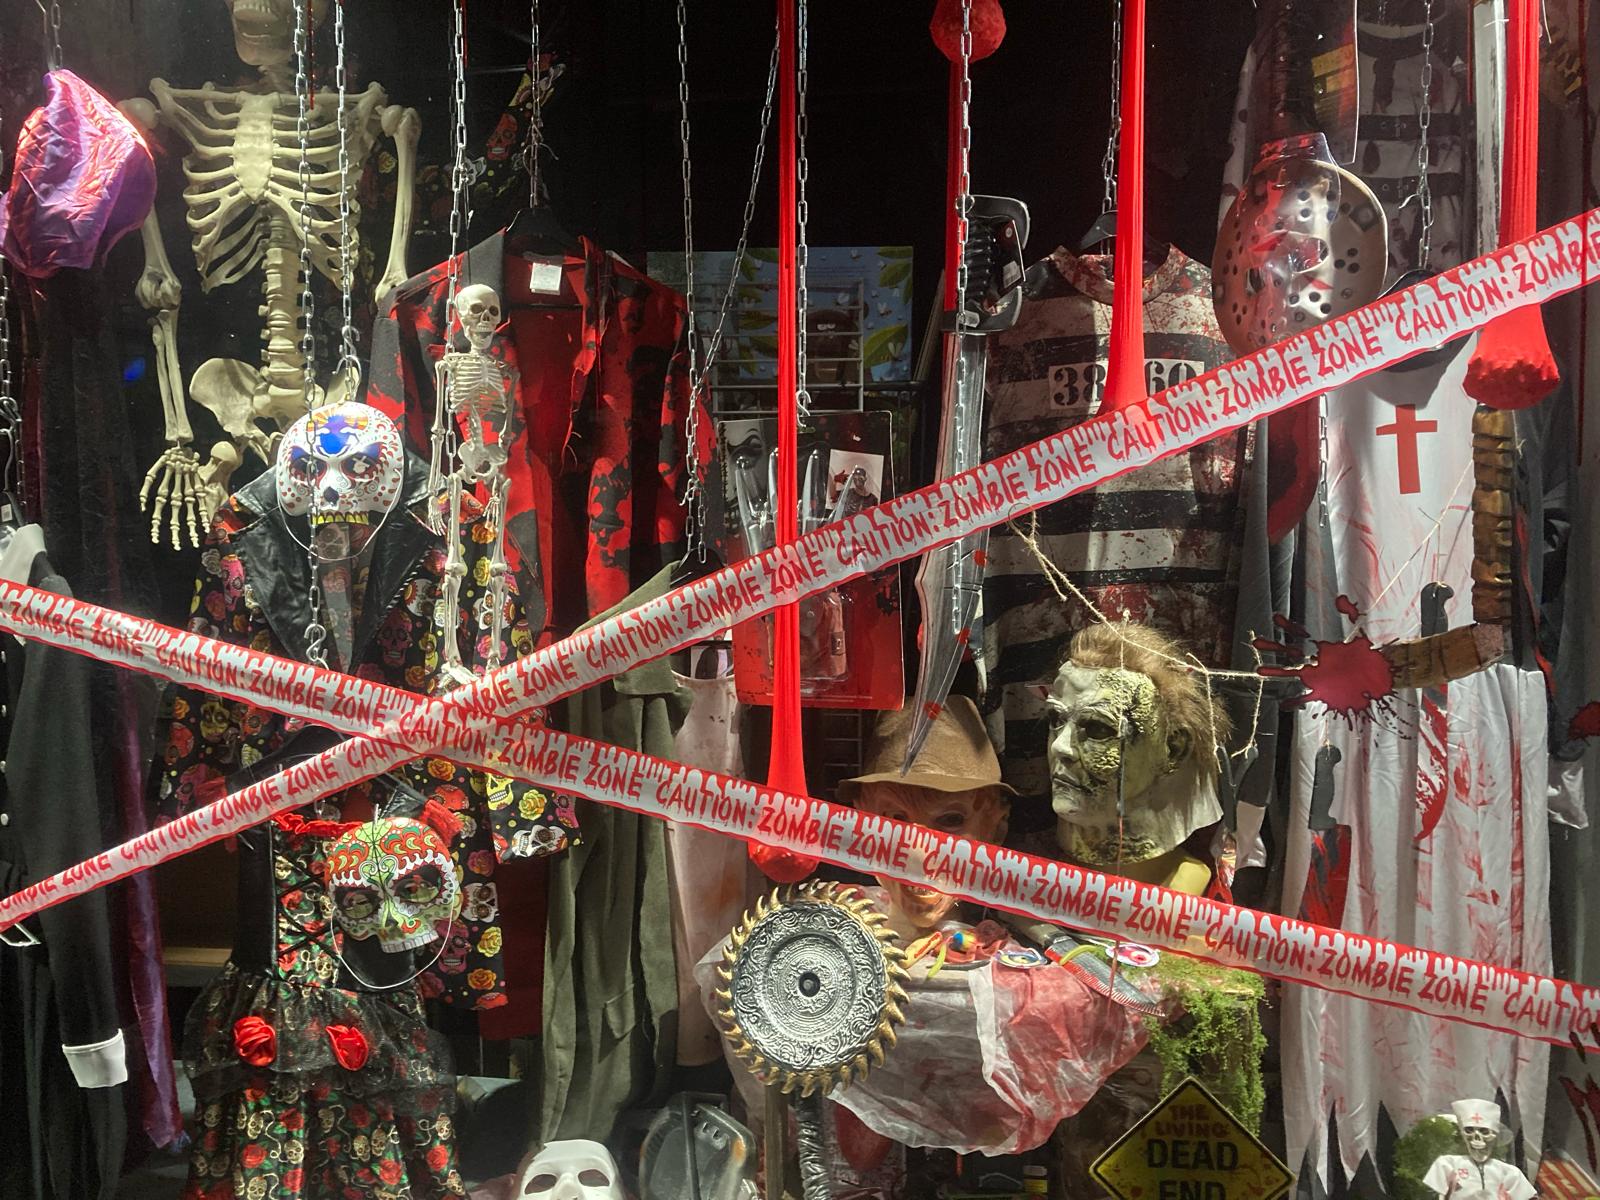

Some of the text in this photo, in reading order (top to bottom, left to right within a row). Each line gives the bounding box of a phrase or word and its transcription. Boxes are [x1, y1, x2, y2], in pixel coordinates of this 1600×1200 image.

[210, 778, 282, 826] ZOMBIE
[283, 754, 338, 796] ZONE
[518, 652, 577, 697] ZONE
[585, 615, 684, 669] CAUTION:
[681, 575, 764, 630] ZOMBIE
[765, 550, 827, 596] ZONE
[837, 510, 940, 565] CAUTION:
[938, 472, 1028, 528] ZOMBIE
[1029, 446, 1096, 492] ZONE
[1107, 398, 1218, 460] CAUTION:
[1216, 356, 1312, 417] ZOMBIE
[1312, 326, 1383, 377] ZONE
[1395, 275, 1514, 341] CAUTION:
[9, 601, 84, 640] ZOMBIE
[91, 627, 144, 657] ZONE
[156, 648, 246, 689] CAUTION:
[250, 669, 326, 710] ZOMBIE
[330, 691, 386, 729] ZONE
[400, 711, 496, 759] CAUTION:
[498, 737, 579, 782] ZOMBIE
[584, 761, 644, 798] ZONE
[656, 780, 753, 828] CAUTION:
[757, 807, 843, 851] ZOMBIE
[847, 831, 910, 868] ZONE
[922, 852, 1027, 902] CAUTION:
[1031, 878, 1120, 924] ZOMBIE
[1125, 903, 1191, 940] ZONE
[1205, 922, 1315, 972] CAUTION:
[1318, 948, 1415, 995] ZOMBIE
[1418, 973, 1489, 1012] ZONE
[1503, 992, 1600, 1033] CAUTIO
[1168, 1104, 1209, 1120] THE
[1147, 1138, 1238, 1171] DEAD
[1159, 1179, 1226, 1200] END
